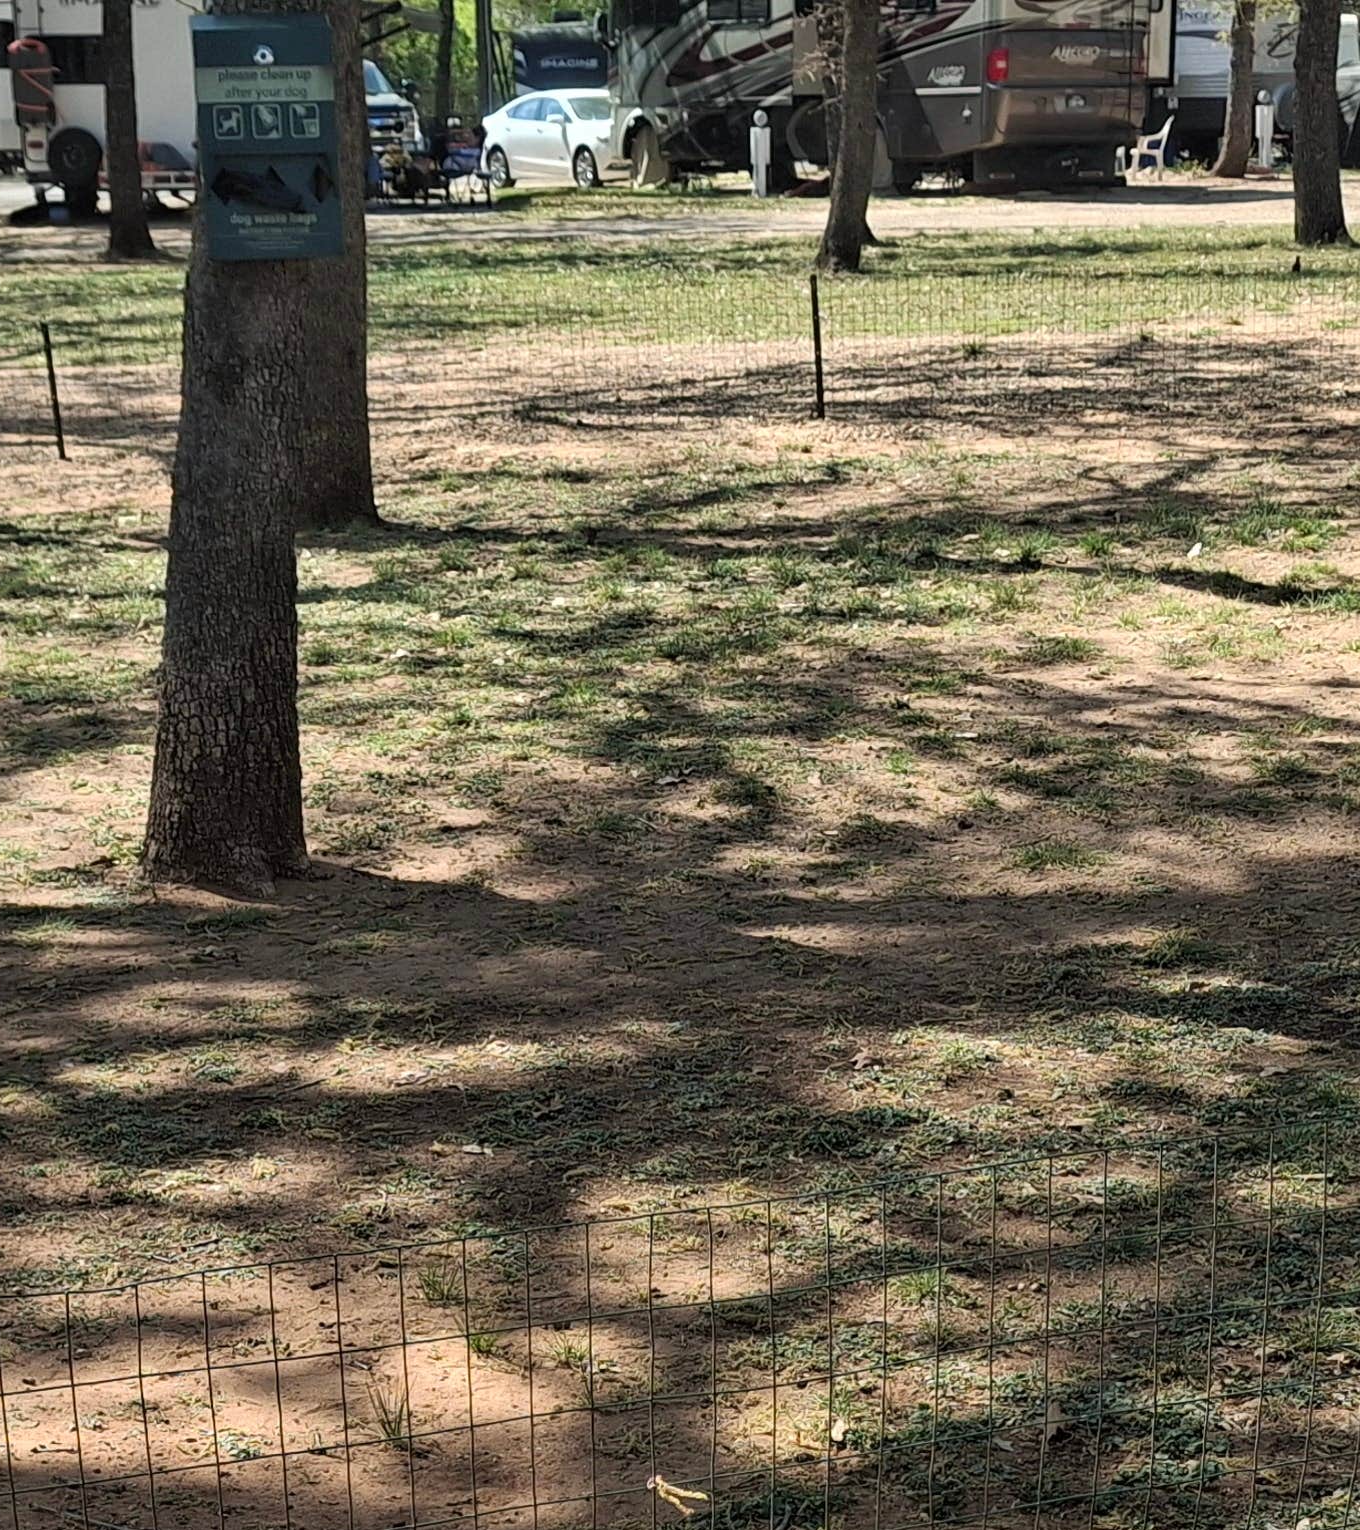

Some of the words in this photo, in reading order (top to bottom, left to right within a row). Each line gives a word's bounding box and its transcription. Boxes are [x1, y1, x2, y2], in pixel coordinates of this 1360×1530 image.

[217, 69, 257, 82] please
[260, 68, 294, 80] clean
[296, 70, 312, 81] up
[224, 86, 251, 98] after
[255, 88, 281, 99] your
[284, 85, 308, 99] dog
[230, 211, 252, 226] dog
